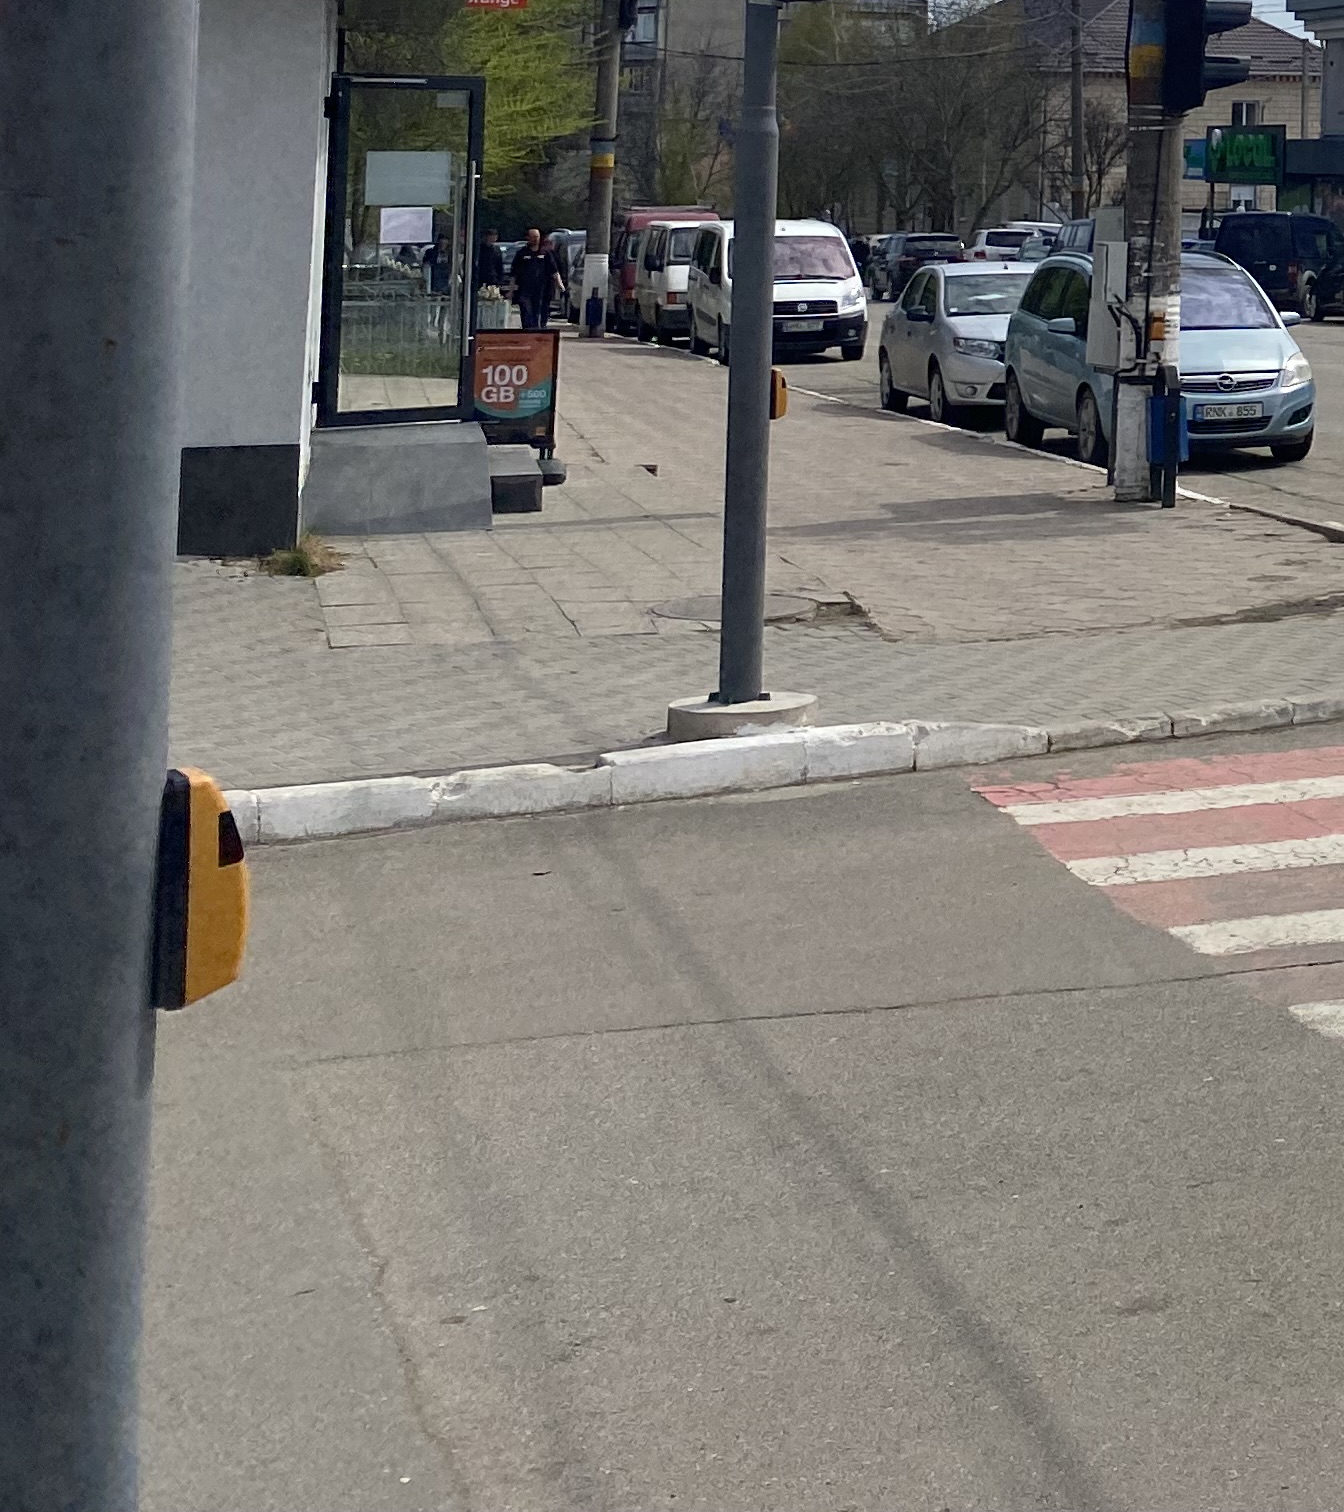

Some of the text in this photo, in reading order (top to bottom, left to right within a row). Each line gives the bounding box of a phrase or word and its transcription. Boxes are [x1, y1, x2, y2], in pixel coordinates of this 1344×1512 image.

[482, 364, 528, 386] 100
[481, 386, 515, 403] GB
[1236, 405, 1256, 416] 855
